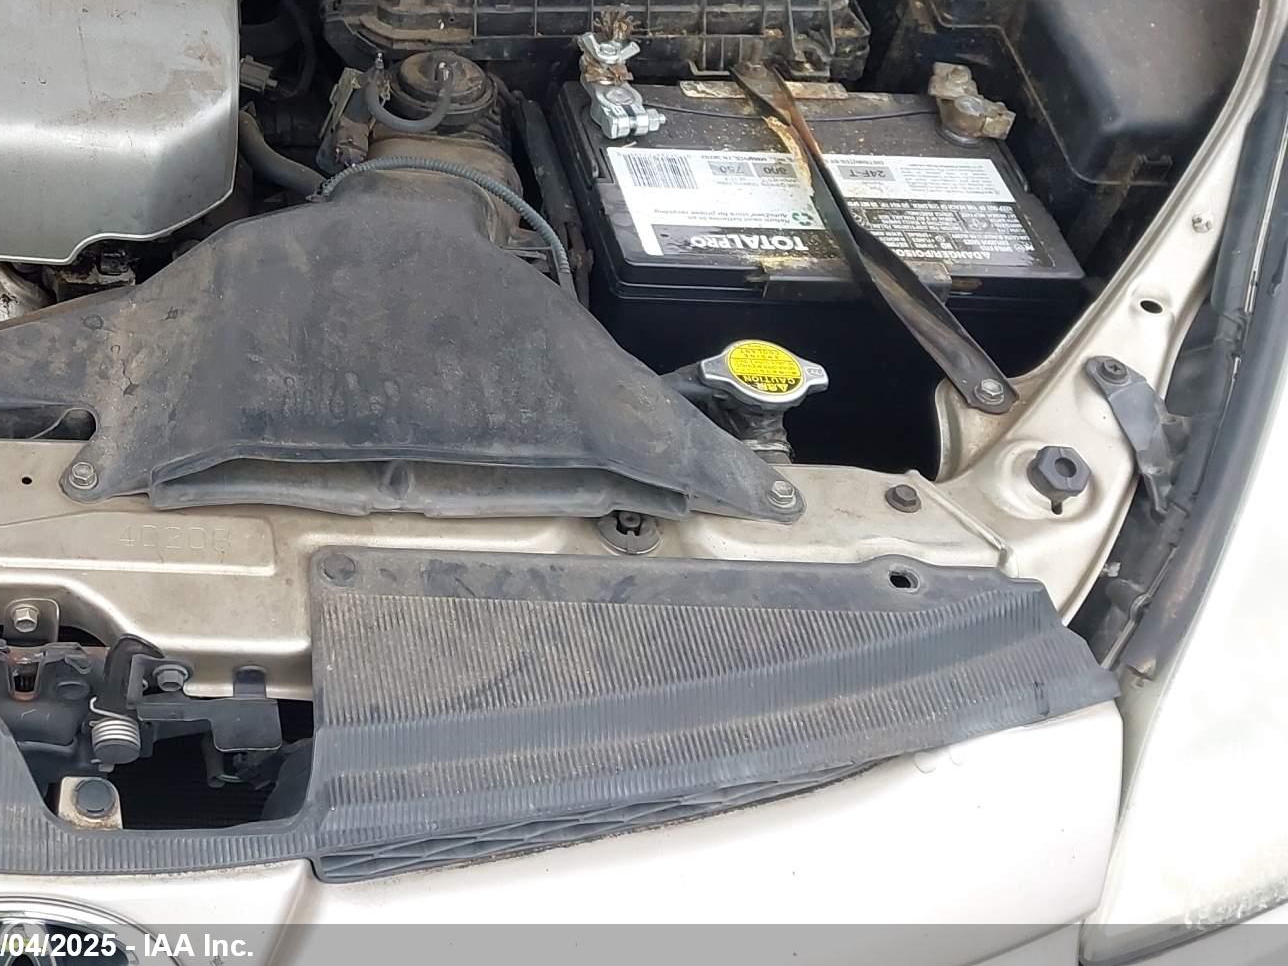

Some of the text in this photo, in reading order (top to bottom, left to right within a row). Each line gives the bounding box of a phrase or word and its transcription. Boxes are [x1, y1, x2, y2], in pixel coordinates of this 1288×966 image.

[849, 169, 886, 179] 24F-T
[690, 234, 808, 251] TOTALPRO
[743, 375, 796, 384] CAUTION
